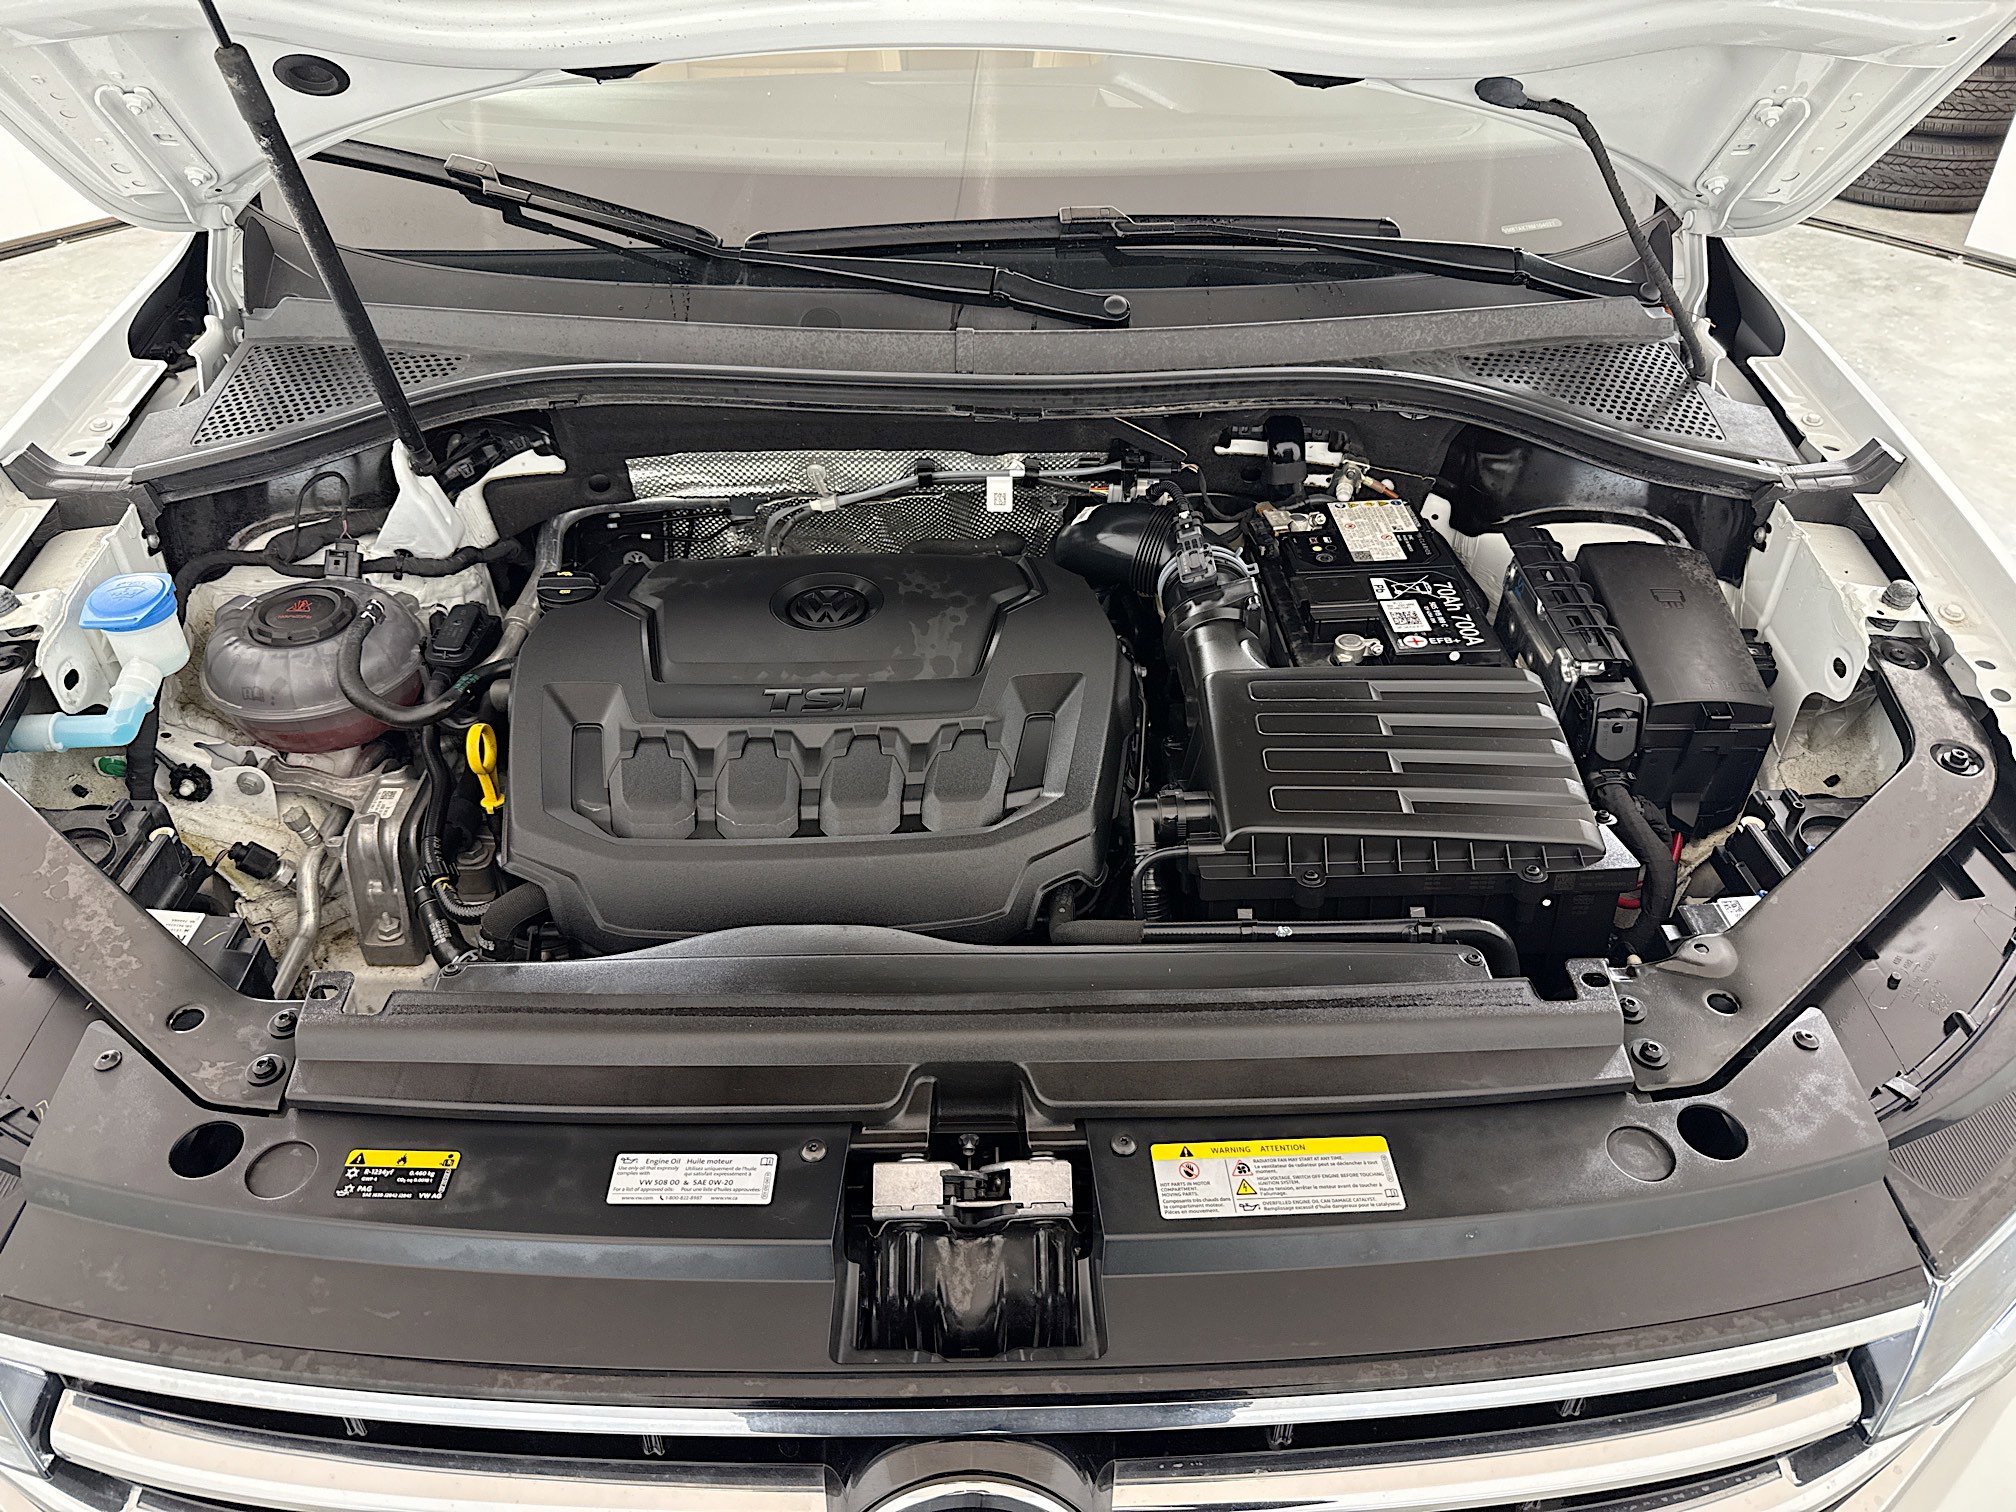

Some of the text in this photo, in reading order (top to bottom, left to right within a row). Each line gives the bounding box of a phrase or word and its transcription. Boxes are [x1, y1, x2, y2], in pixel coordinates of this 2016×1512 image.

[1374, 584, 1385, 594] Pb
[1433, 582, 1464, 612] 70Ah
[1451, 614, 1485, 646] 700A
[763, 688, 866, 712] TSI
[1210, 1144, 1306, 1154] WARNING ATTENTION
[364, 1169, 394, 1177] R-1234yf
